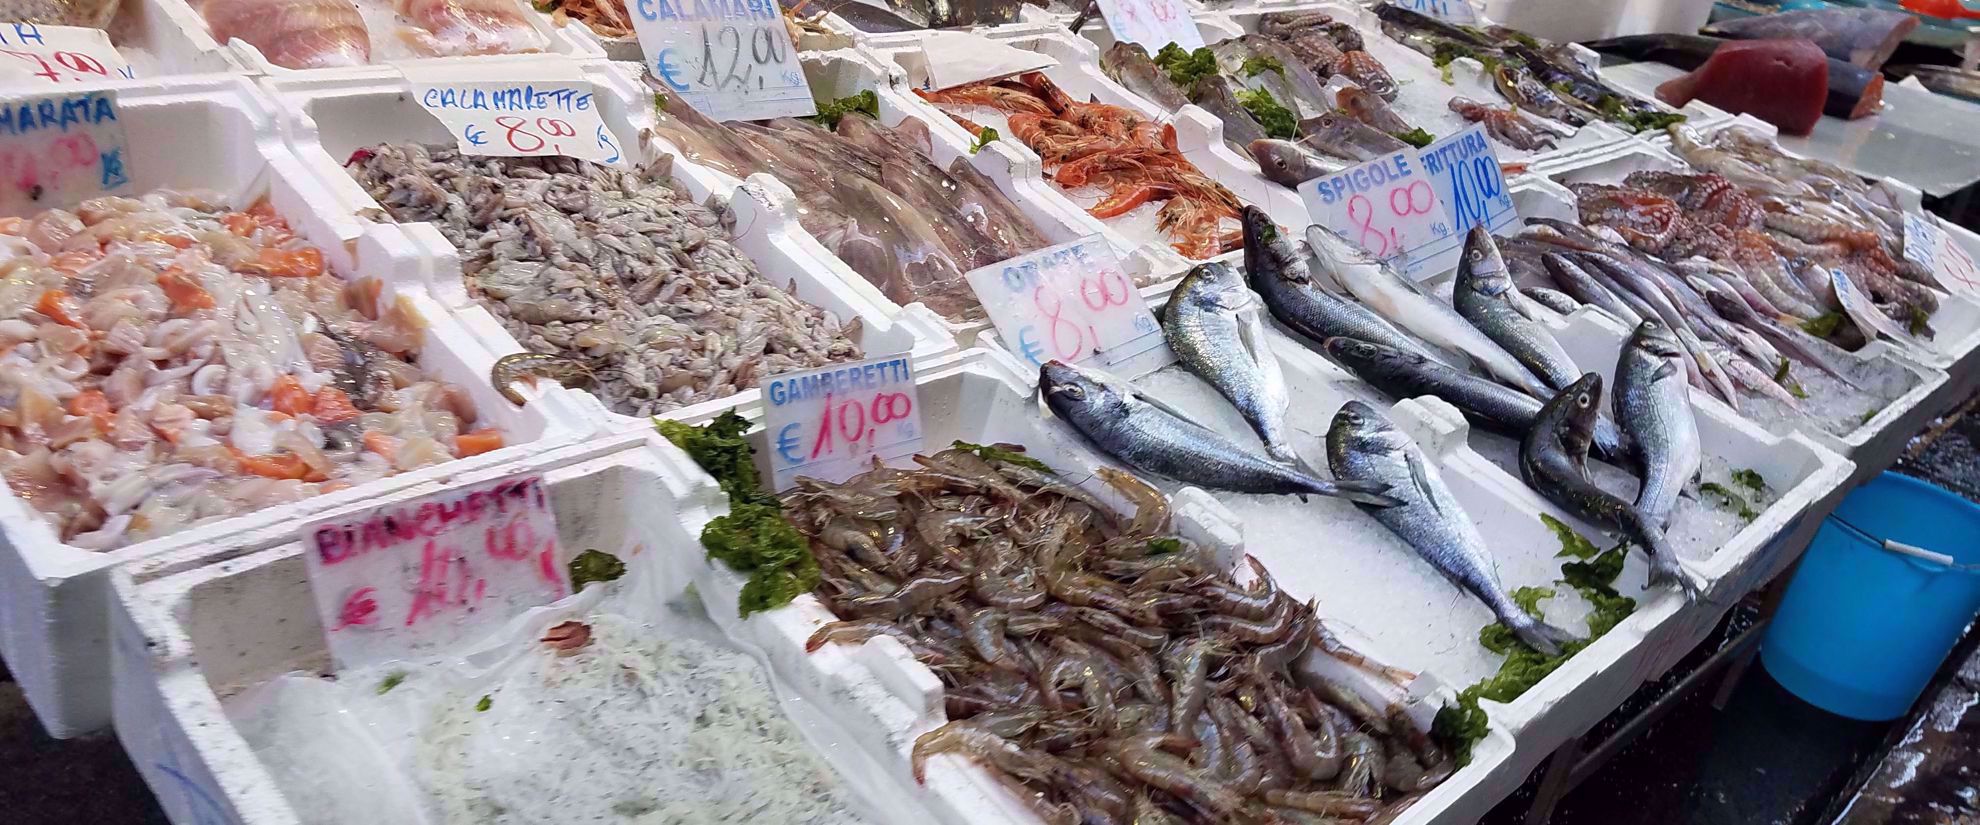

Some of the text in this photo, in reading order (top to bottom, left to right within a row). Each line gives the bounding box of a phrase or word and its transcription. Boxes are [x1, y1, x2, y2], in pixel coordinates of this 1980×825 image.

[657, 48, 690, 91] €
[1317, 153, 1413, 205] SPIGOLE
[768, 357, 910, 407] GAMBERETTI
[775, 422, 807, 465] €
